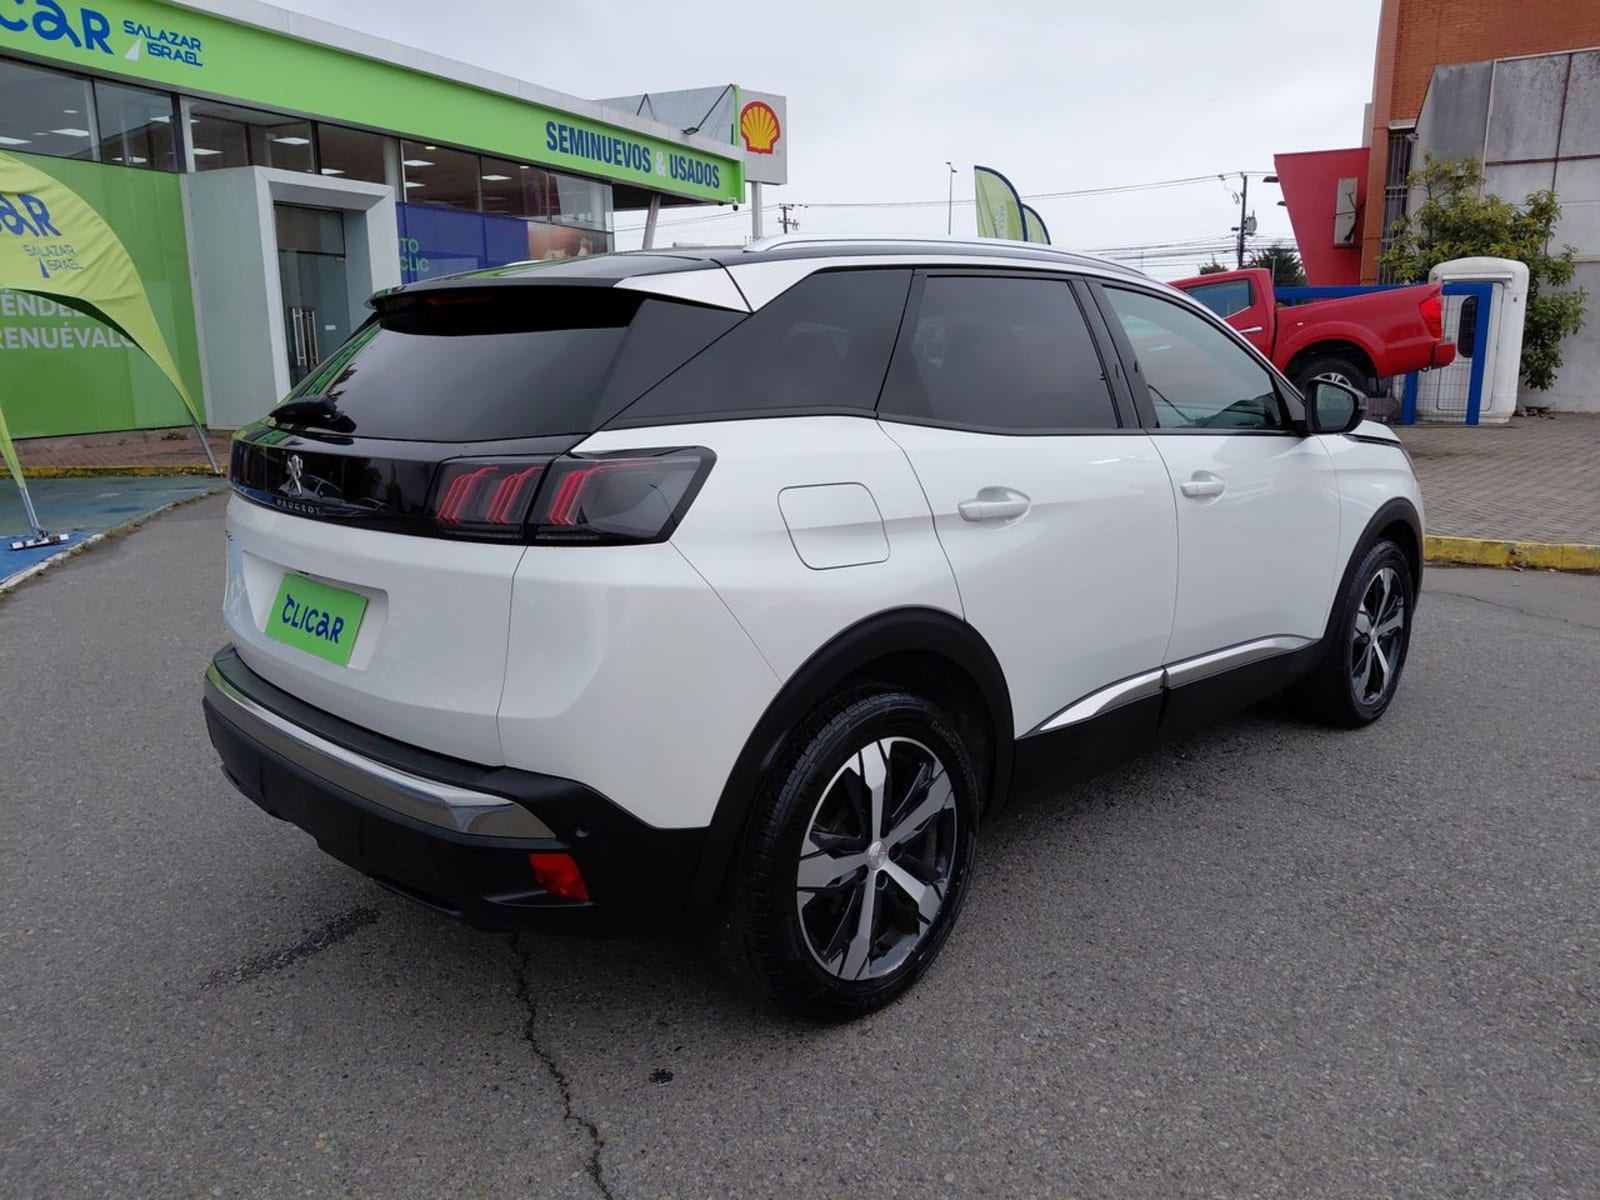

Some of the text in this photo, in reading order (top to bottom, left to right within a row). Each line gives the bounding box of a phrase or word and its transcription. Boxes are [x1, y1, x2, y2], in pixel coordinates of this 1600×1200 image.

[123, 20, 202, 51] SALAZAR
[147, 42, 203, 67] ISRAEL
[545, 120, 721, 189] SEMINUEVOS & USADOS
[23, 244, 77, 257] SALAZAR
[400, 256, 430, 272] CLIC
[0, 321, 135, 349] ENUÉVAL
[276, 498, 321, 516] PEUGEOT
